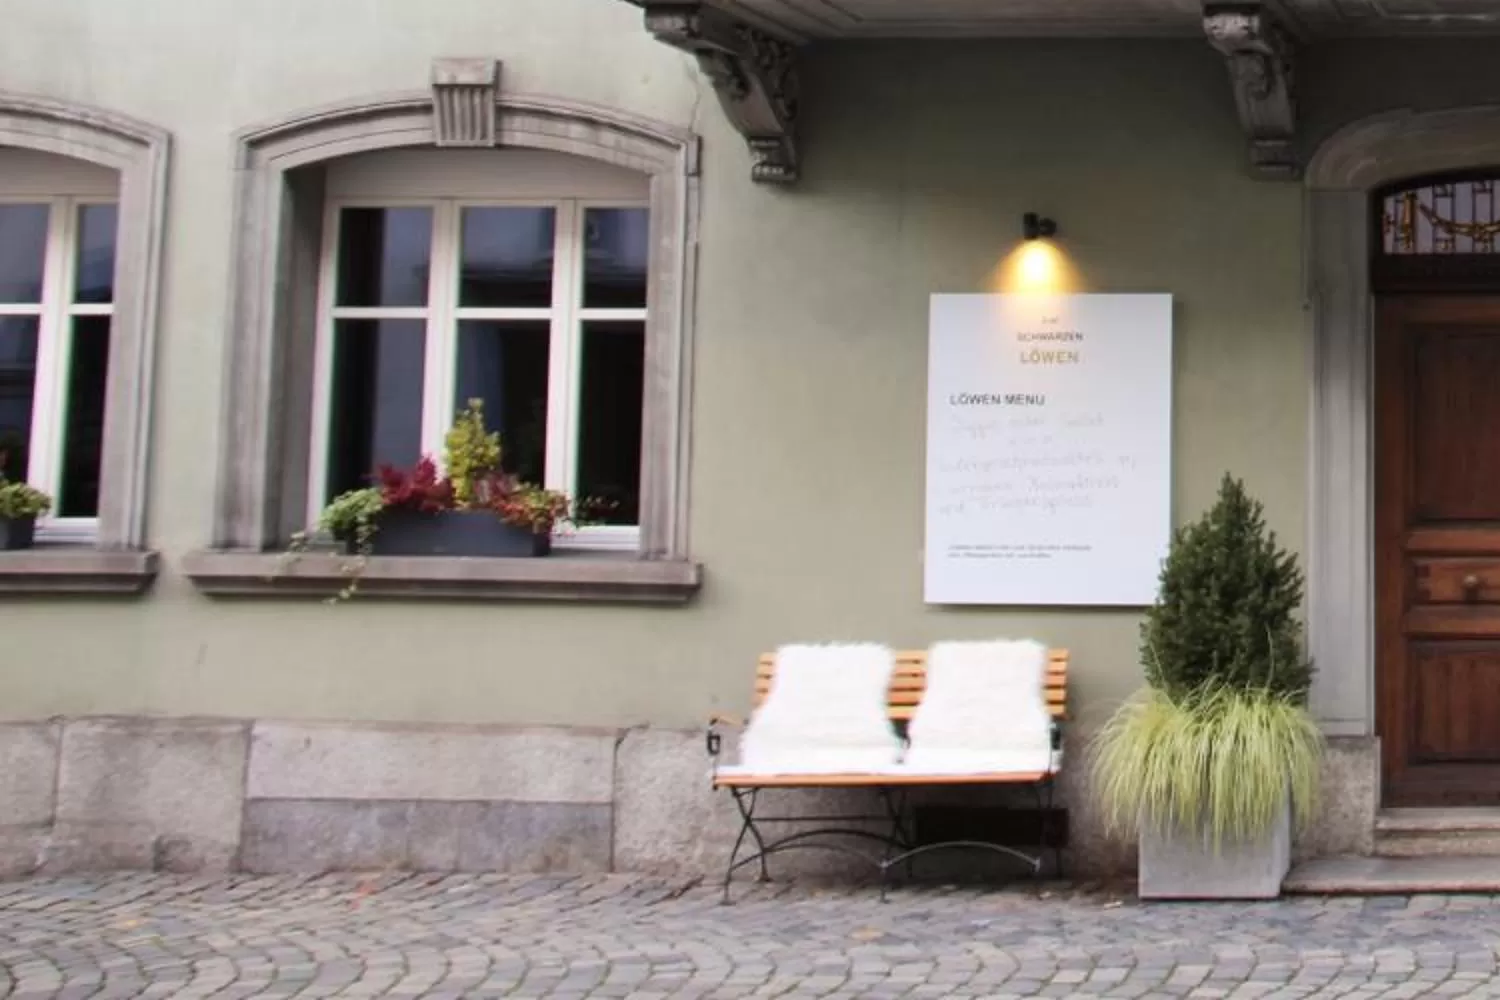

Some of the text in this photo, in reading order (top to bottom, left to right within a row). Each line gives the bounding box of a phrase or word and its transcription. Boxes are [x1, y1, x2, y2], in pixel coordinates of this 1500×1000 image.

[1020, 348, 1080, 364] LÖWEN
[950, 391, 1046, 406] LÖWEN MENU
